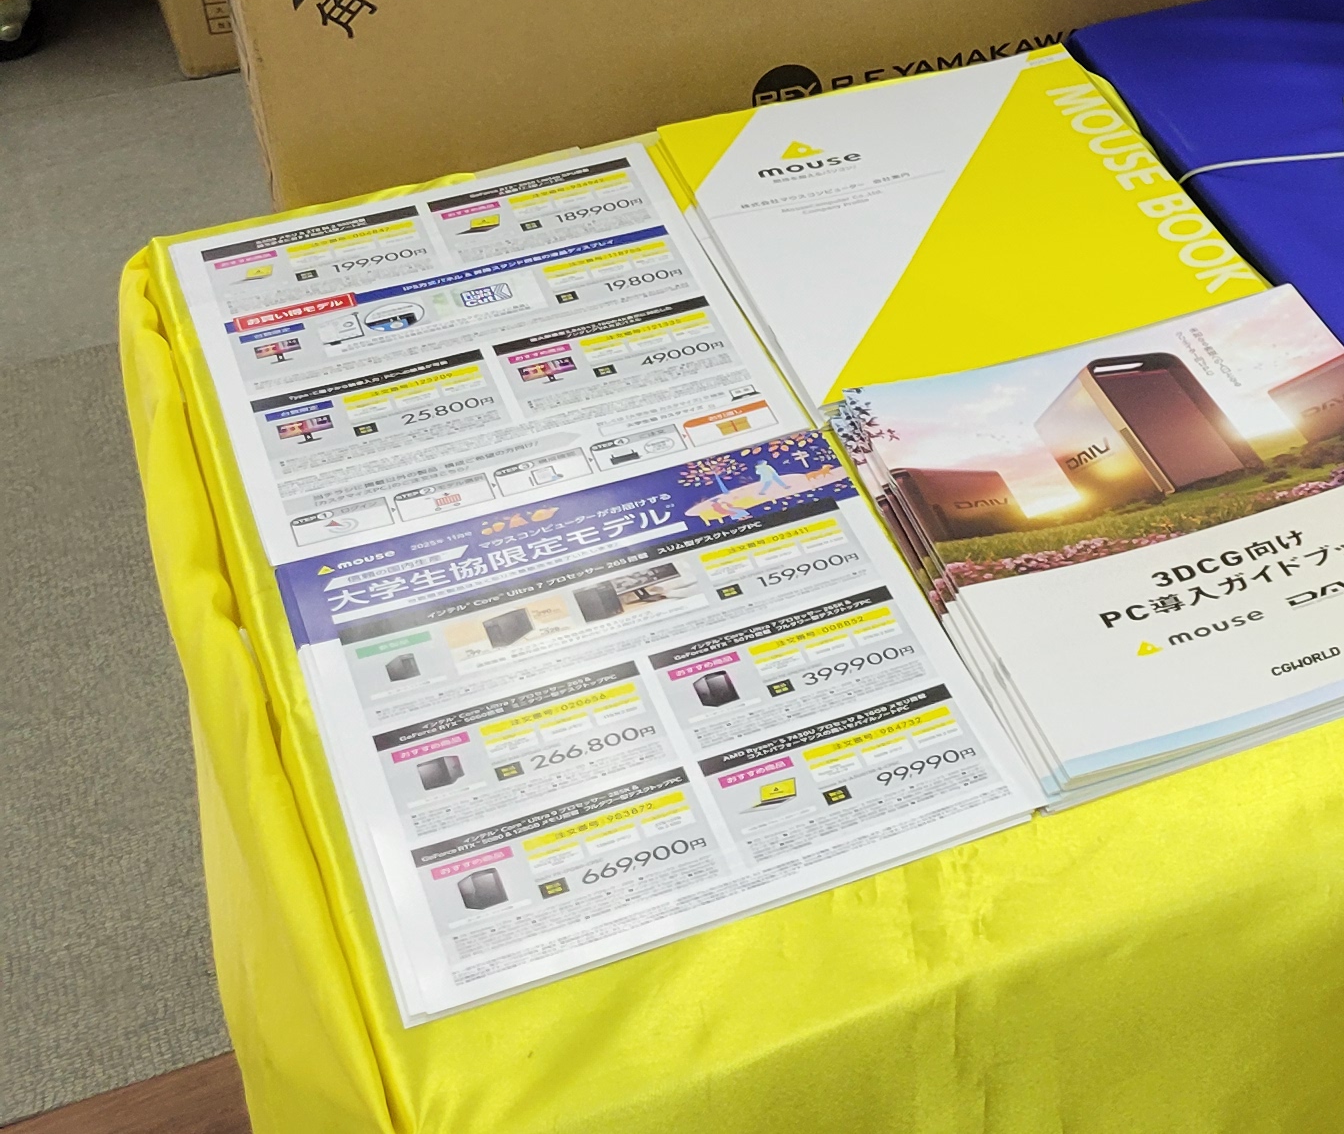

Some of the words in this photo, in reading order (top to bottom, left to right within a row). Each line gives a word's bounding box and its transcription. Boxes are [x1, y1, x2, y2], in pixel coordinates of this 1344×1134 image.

[757, 149, 863, 181] mouse
[1045, 80, 1171, 193] MOUSE
[1137, 197, 1257, 295] BOOK
[554, 194, 644, 224] 189,900円
[331, 242, 428, 275] 199,900円
[603, 264, 684, 293] 19,800円
[245, 296, 345, 328] お買い得モデル
[636, 336, 726, 368] 49,000円
[399, 391, 496, 426] 25,800円
[614, 436, 628, 445] 4
[477, 491, 674, 550] マウスコンピューターがお届けする
[324, 503, 676, 613] 大学生協限定モデル
[335, 548, 397, 570] mouse
[505, 584, 535, 598] Ultra
[544, 564, 606, 587] プロセッサー
[655, 519, 764, 555] スリム型デスクトップPC
[754, 548, 862, 589] 159,900円
[1150, 528, 1306, 590] 3DCG向け
[1168, 606, 1266, 648] mouse
[673, 655, 735, 678] おすすめ商品
[799, 641, 917, 687] 399,900円
[1270, 645, 1342, 678] CGWORLD
[398, 735, 464, 759] おすすめ商品
[527, 720, 658, 771] 266,800円
[721, 749, 746, 762] AMD
[724, 759, 787, 785] おすすめ商品
[873, 742, 979, 789] 99,990円
[577, 832, 709, 886] 669,900円
